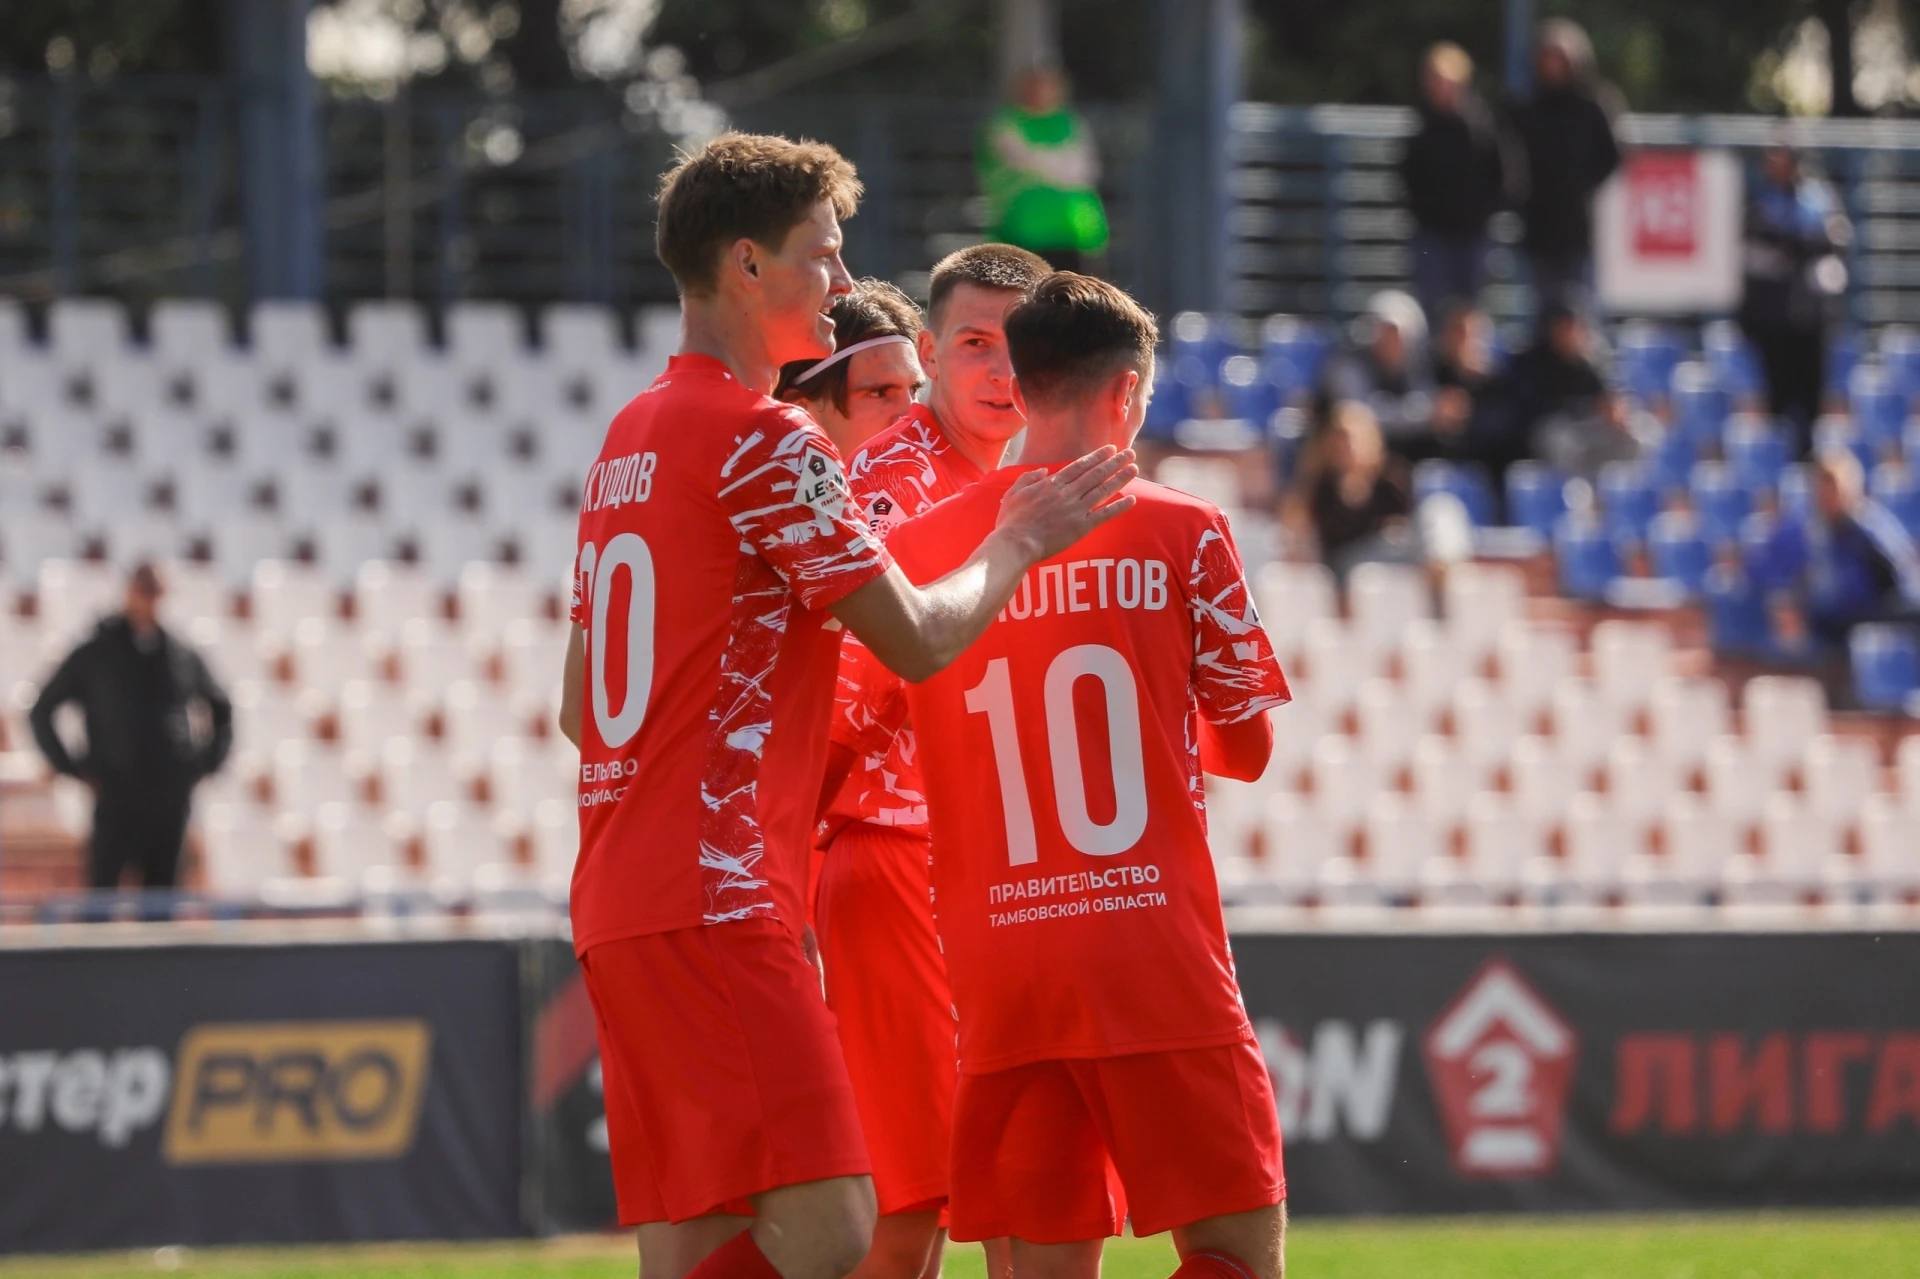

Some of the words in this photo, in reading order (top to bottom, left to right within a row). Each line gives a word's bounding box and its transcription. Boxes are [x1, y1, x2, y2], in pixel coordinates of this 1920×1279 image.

[813, 461, 823, 471] 2
[877, 503, 887, 511] 2
[998, 558, 1168, 622] ОЛЕТОВ
[963, 643, 1148, 867] 10
[989, 864, 1160, 905] ПРАВИТЕЛЬСТВО
[989, 898, 1090, 928] ТАМБОВСКОЙ
[1092, 892, 1167, 913] ОБЛАСТИ
[185, 1046, 402, 1134] PRO
[1468, 1042, 1534, 1118] 2
[1610, 1032, 1920, 1136] ЛИГА
